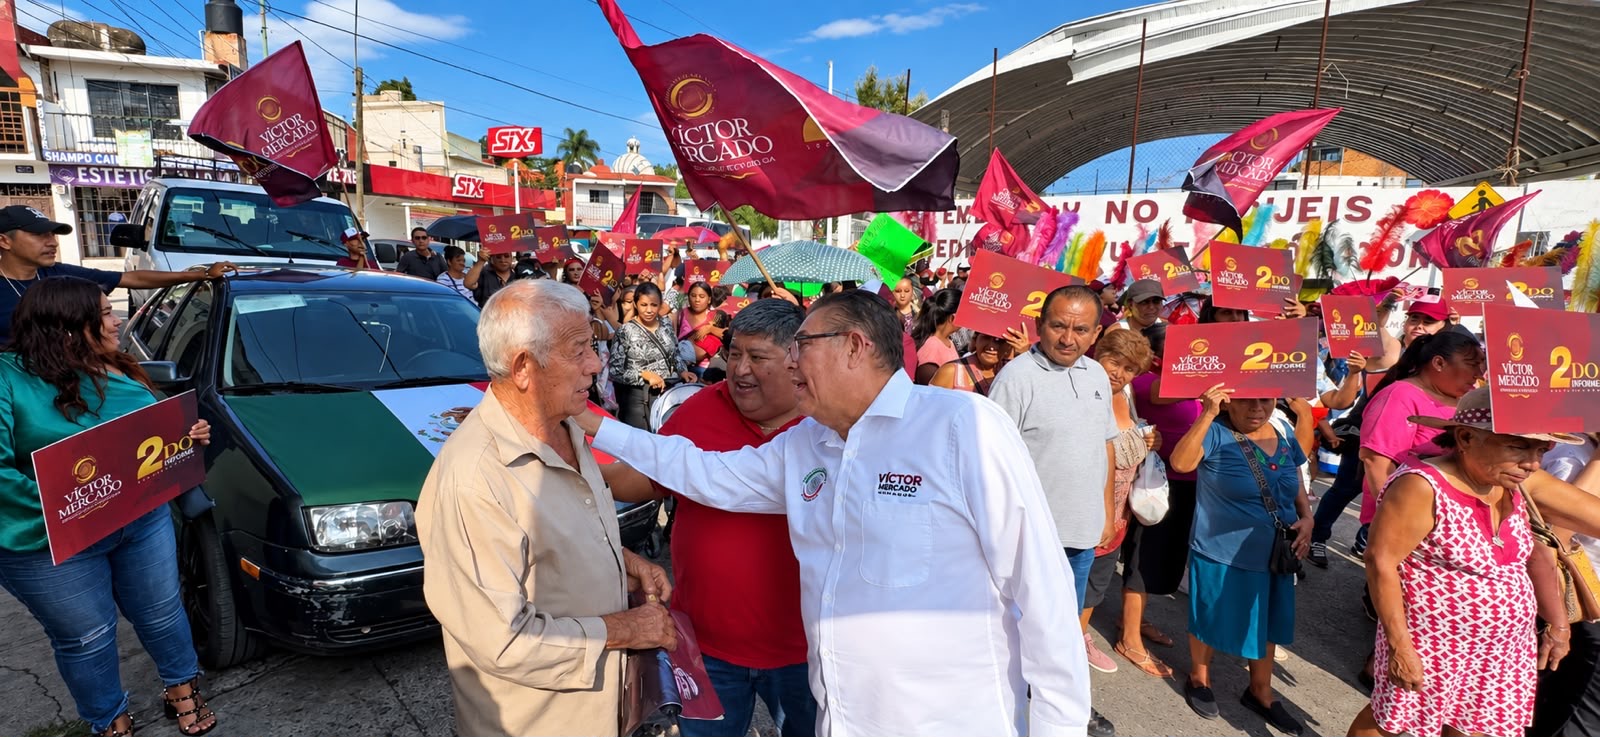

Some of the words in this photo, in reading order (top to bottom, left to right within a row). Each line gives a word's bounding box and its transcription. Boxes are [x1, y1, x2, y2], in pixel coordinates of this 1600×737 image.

[259, 113, 305, 143] VÍCTOR
[45, 151, 92, 163] SHAMPO
[1105, 199, 1159, 223] NO
[1255, 265, 1290, 288] 2DO
[969, 292, 1012, 310] MERCADO
[981, 287, 1008, 302] VÍCTOR
[1353, 314, 1377, 336] 2DO
[1179, 354, 1219, 364] VÍCTOR
[1240, 342, 1307, 370] 2DO
[1172, 362, 1226, 371] MERCADO
[1501, 360, 1534, 375] VÍCTOR
[1550, 346, 1599, 388] 2DO
[1498, 374, 1540, 387] MERCADO
[1571, 380, 1600, 388] INFORME
[137, 435, 193, 480] 2DO
[64, 473, 112, 503] VÍCTOR
[879, 472, 922, 486] VÍCTOR
[878, 484, 917, 493] MERCADO
[58, 479, 122, 519] MERCADO
